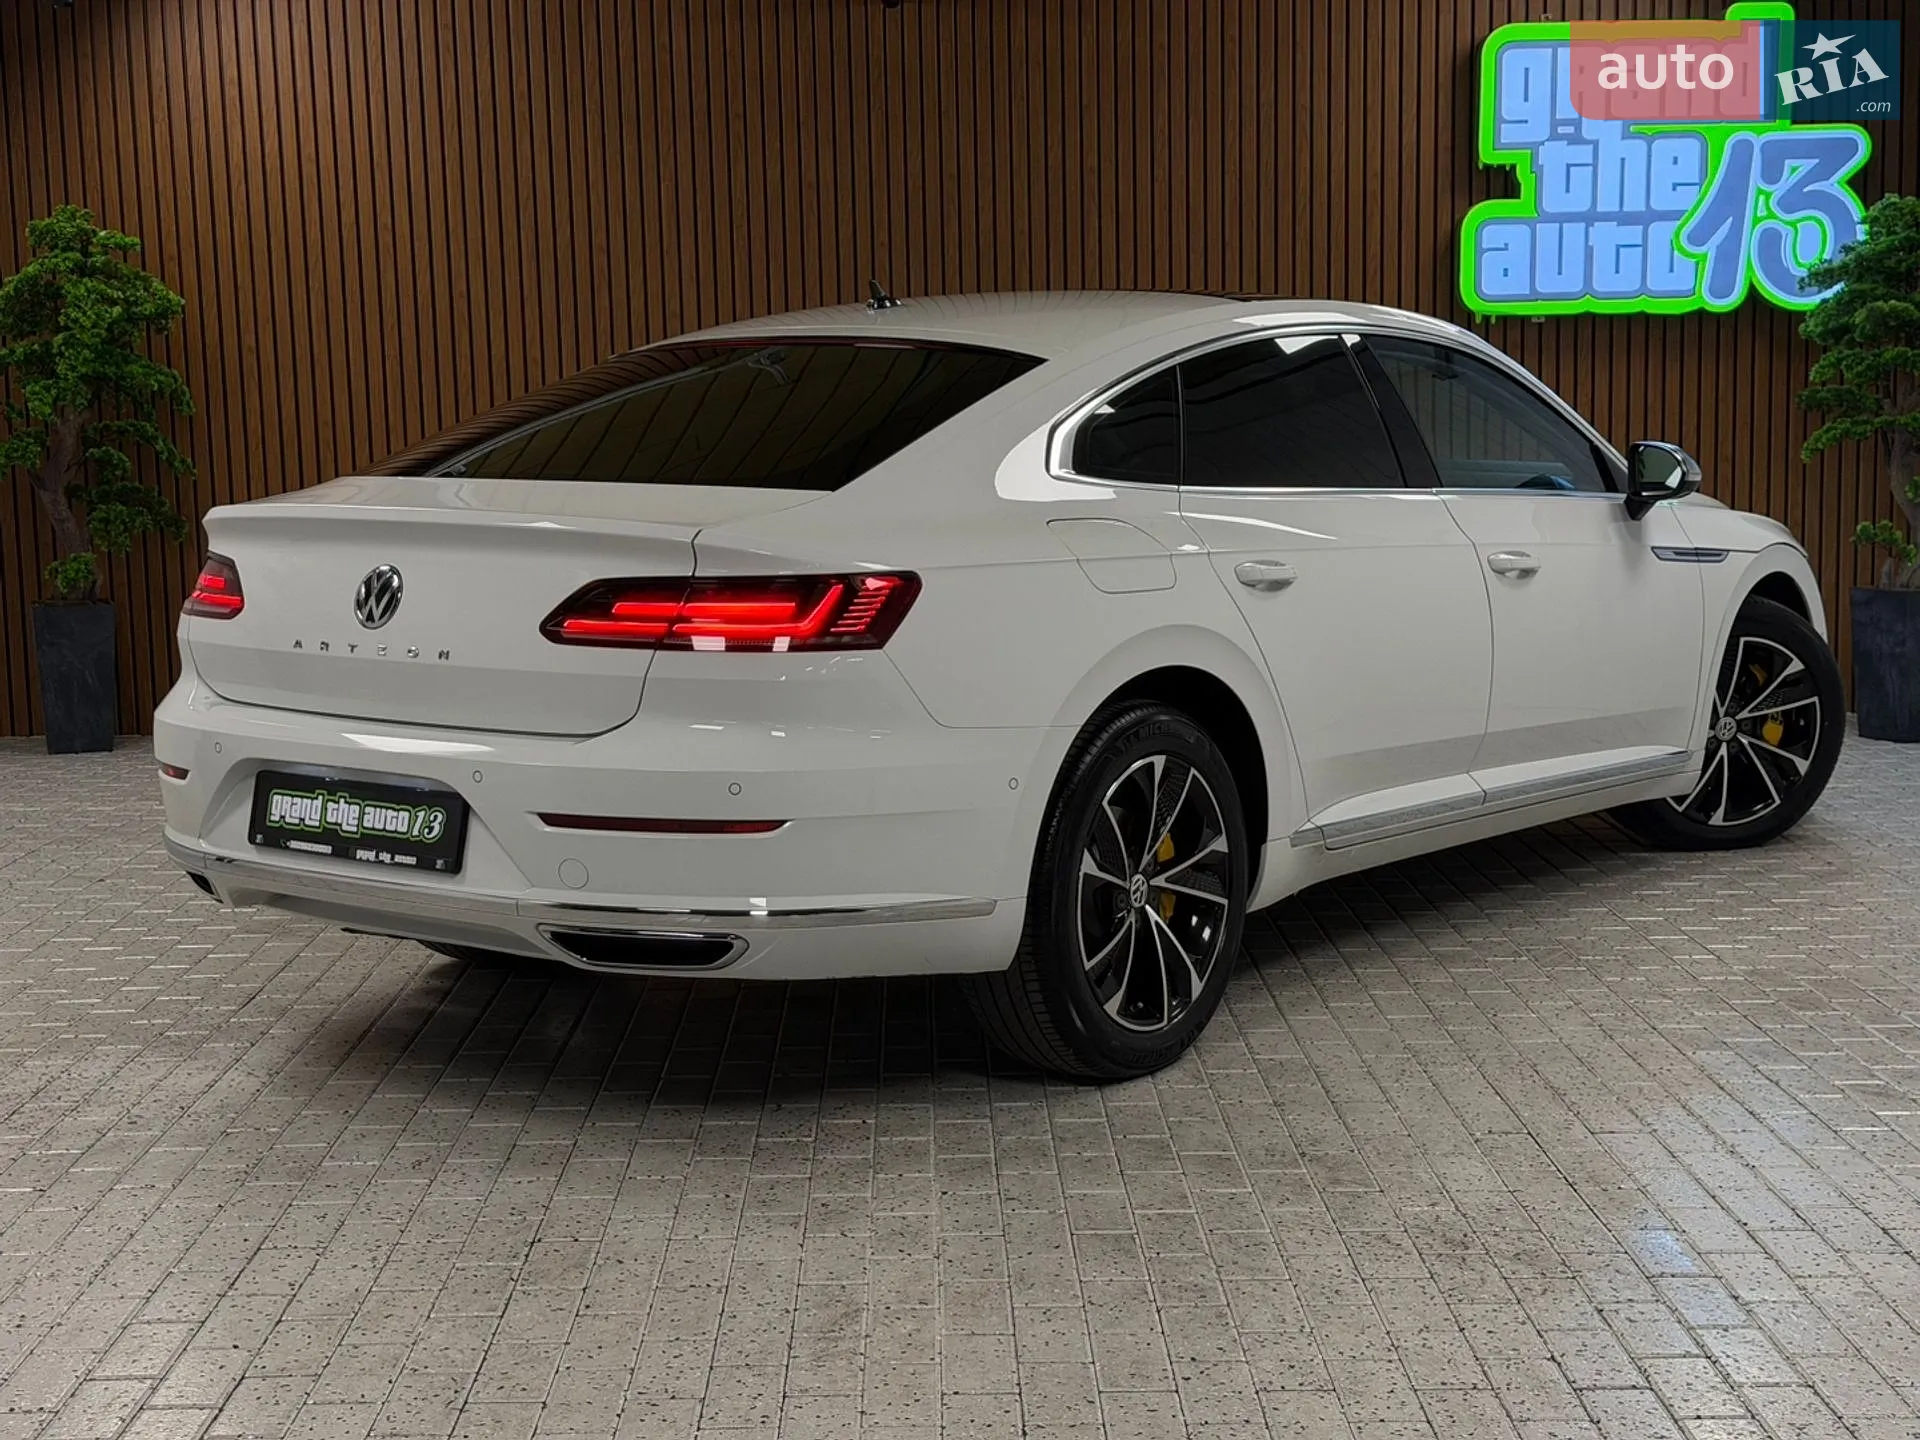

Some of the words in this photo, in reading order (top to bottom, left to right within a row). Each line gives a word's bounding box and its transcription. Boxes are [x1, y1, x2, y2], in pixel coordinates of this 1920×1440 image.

[1539, 118, 1701, 212] the
[1480, 221, 1698, 297] auto
[1680, 132, 1869, 304] 13
[292, 638, 451, 661] ARTEON
[269, 795, 324, 828] grand
[326, 798, 361, 833] the
